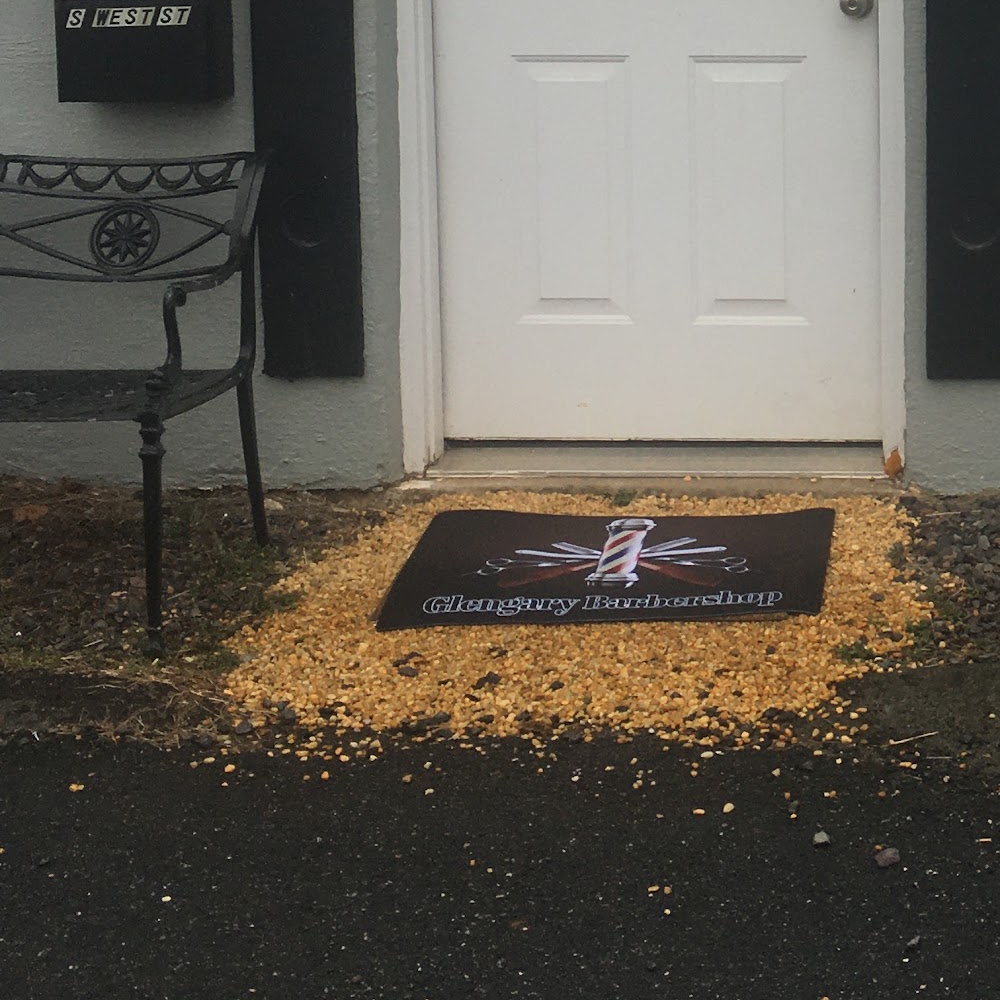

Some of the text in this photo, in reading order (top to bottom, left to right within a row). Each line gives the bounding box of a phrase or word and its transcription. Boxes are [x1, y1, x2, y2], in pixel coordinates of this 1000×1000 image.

[69, 8, 189, 26] S WEST ST
[422, 590, 782, 616] Glengary Barbershop
